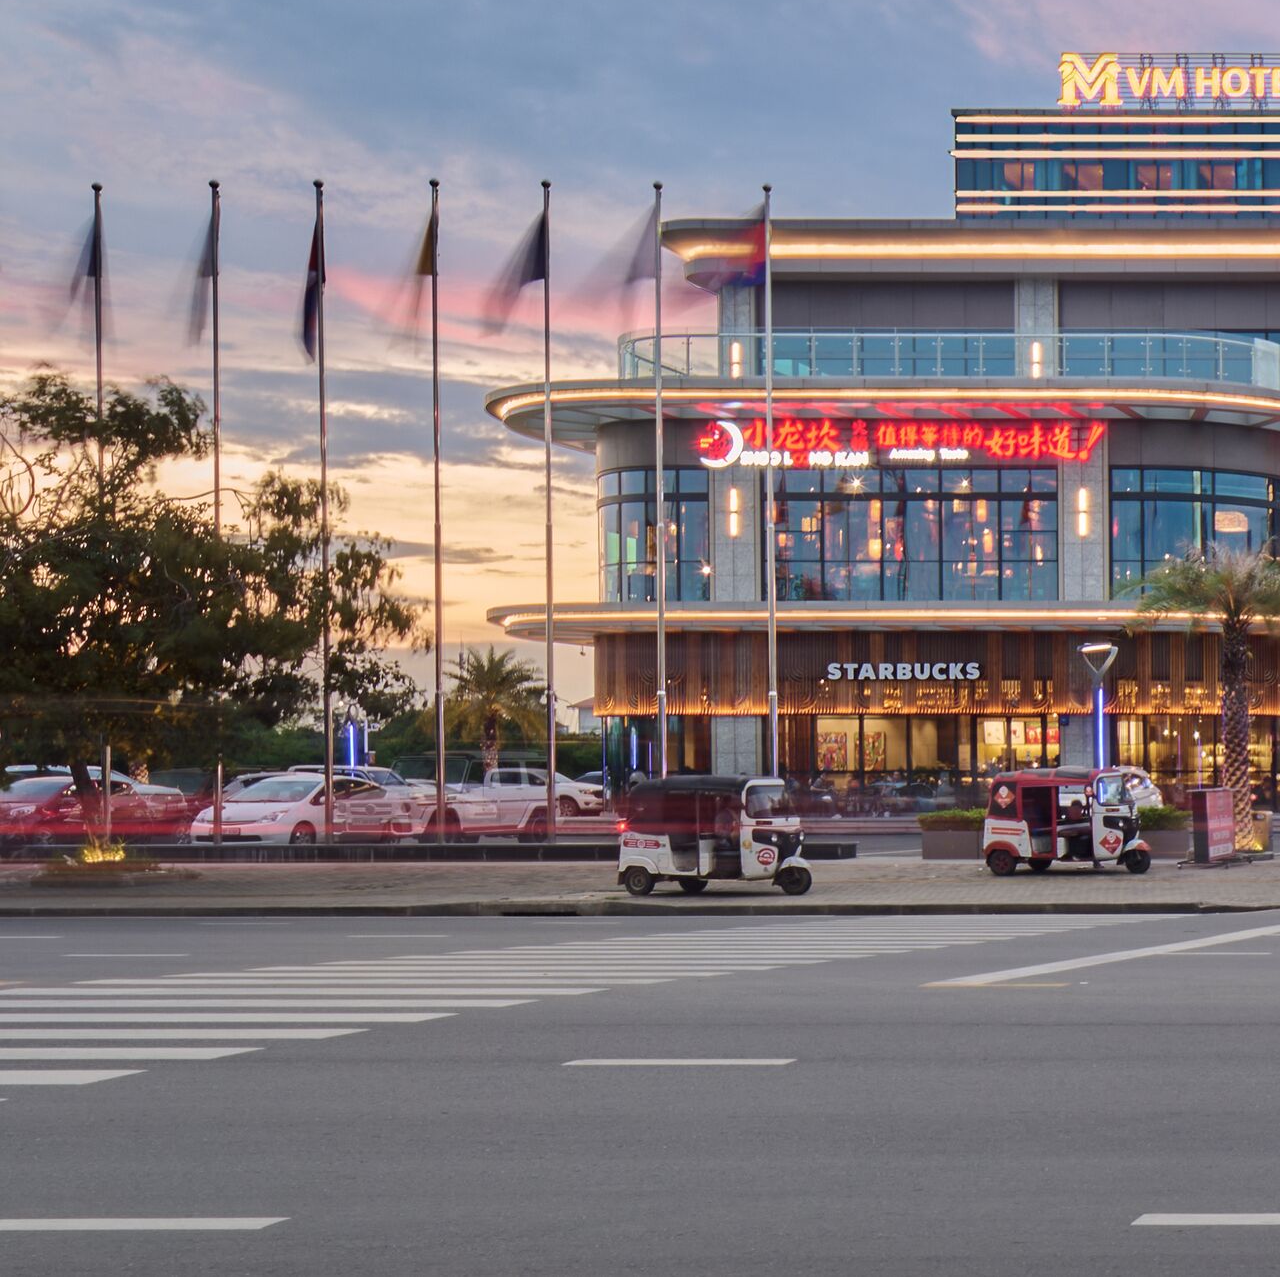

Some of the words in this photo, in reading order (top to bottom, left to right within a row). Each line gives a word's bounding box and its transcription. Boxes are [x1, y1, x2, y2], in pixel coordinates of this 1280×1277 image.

[1125, 66, 1188, 98] VM
[742, 418, 843, 452] 小龙坎
[826, 662, 982, 681] STARBUCKS
